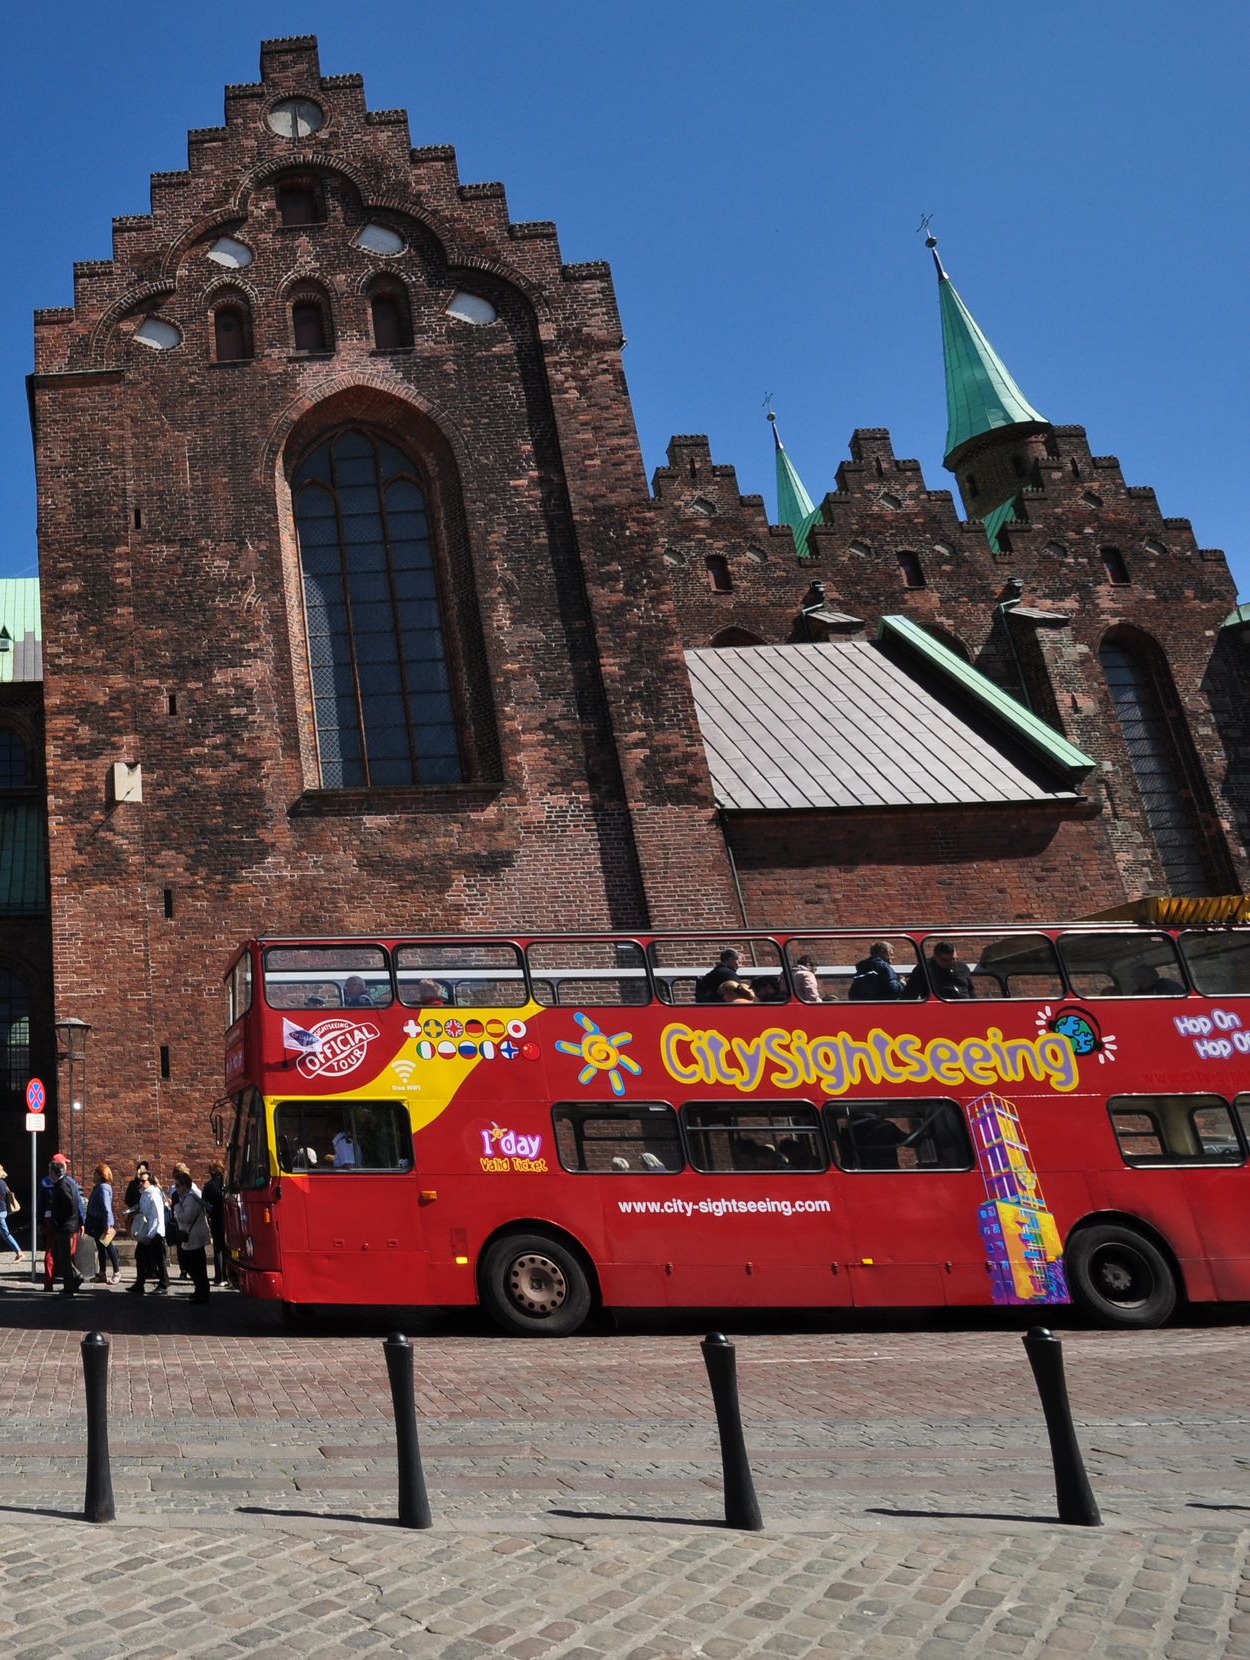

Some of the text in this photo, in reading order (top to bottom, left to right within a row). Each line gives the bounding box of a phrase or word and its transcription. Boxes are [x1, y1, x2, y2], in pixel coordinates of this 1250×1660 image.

[1173, 1008, 1242, 1036] Hop On
[305, 1026, 375, 1071] OFFICIAL
[333, 1048, 364, 1072] TOUR
[660, 1022, 1080, 1095] CitySightseeing
[1193, 1038, 1234, 1060] Hop
[500, 1129, 542, 1160] day
[480, 1156, 548, 1173] Valid Ticket
[618, 1198, 831, 1216] www.city-sightseeing.com
